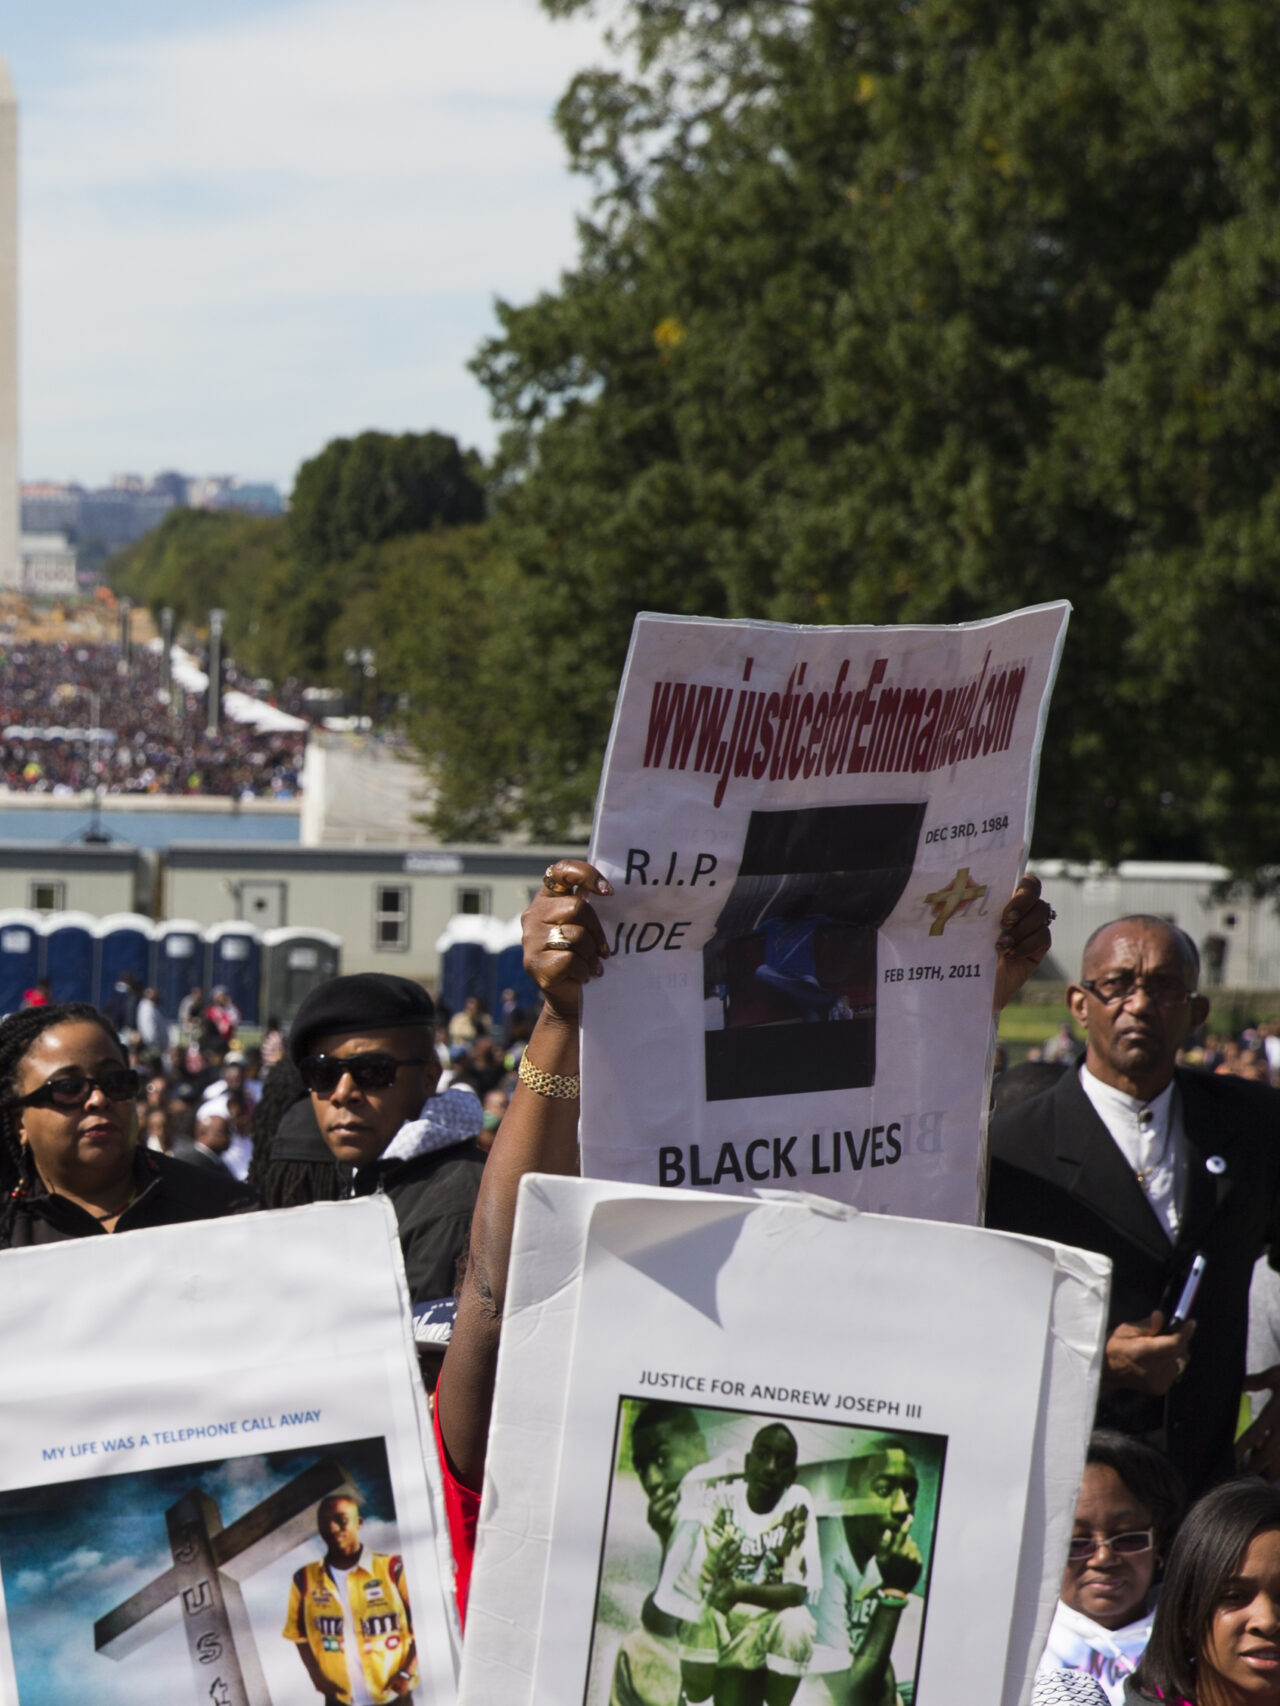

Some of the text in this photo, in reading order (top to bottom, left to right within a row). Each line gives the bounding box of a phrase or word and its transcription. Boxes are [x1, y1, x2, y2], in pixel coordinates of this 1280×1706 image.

[925, 815, 1009, 845] DEC 3RD, 1984
[624, 848, 718, 887] R.I.P.
[884, 963, 981, 983] FEB 19TH, 2011
[658, 1135, 798, 1188] BLACK
[811, 1122, 902, 1175] LIVES
[639, 1370, 923, 1419] JUSTICE FOR ANDREW JOSEPH III
[42, 1409, 322, 1462] MY LIFE WAS A TELEPHONE CALL AWAY
